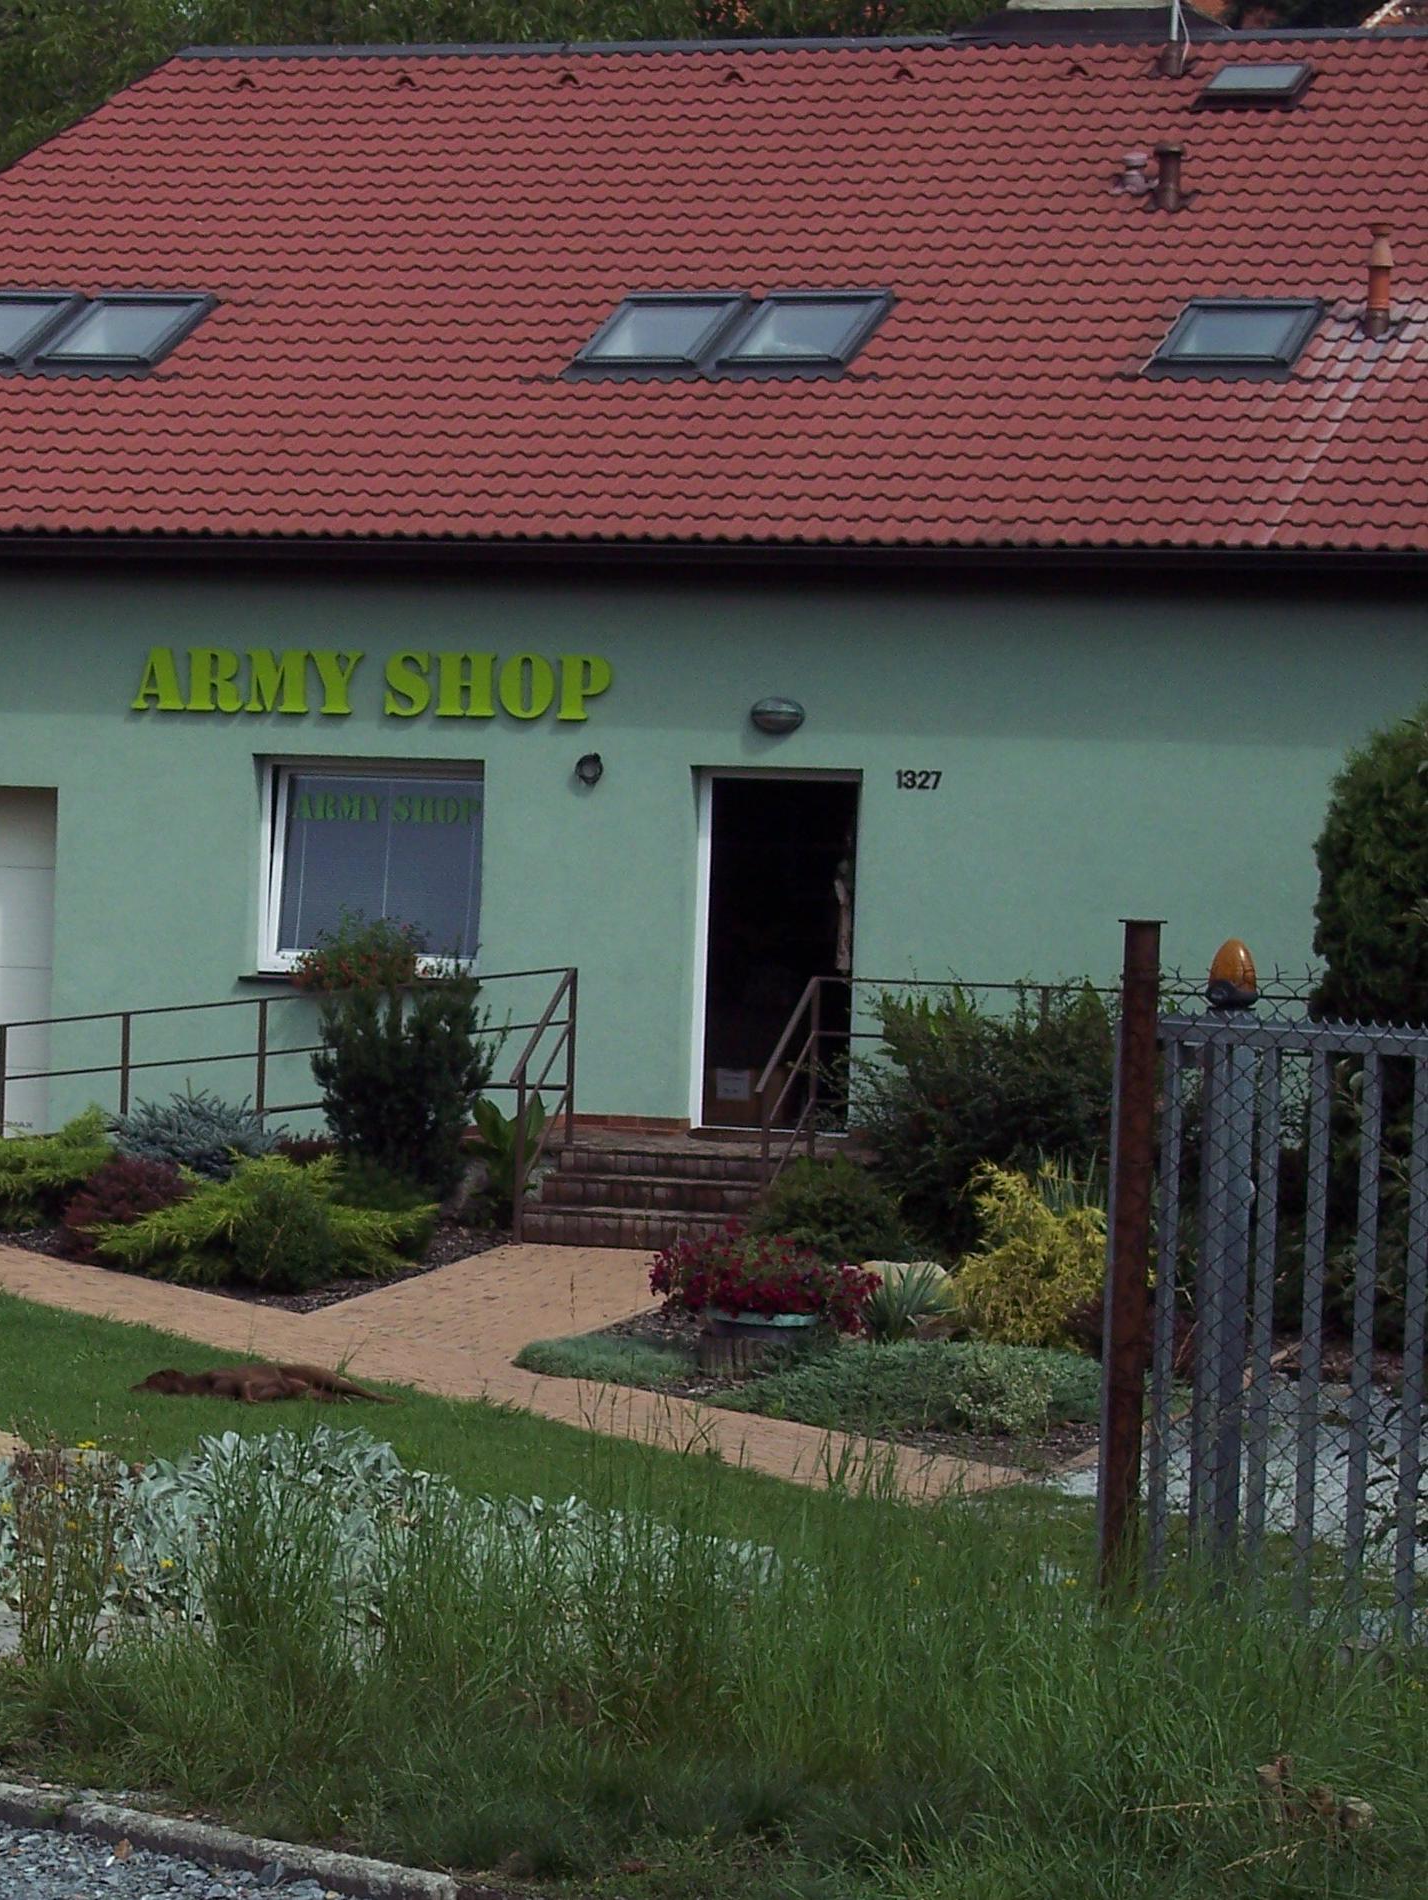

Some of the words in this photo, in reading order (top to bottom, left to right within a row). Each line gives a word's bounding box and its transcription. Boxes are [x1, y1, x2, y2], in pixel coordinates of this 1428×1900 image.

[131, 647, 365, 716] ARMY
[384, 650, 613, 722] SHOP
[895, 769, 943, 790] 1327
[292, 791, 382, 822] ARMY
[391, 794, 482, 825] SHOP
